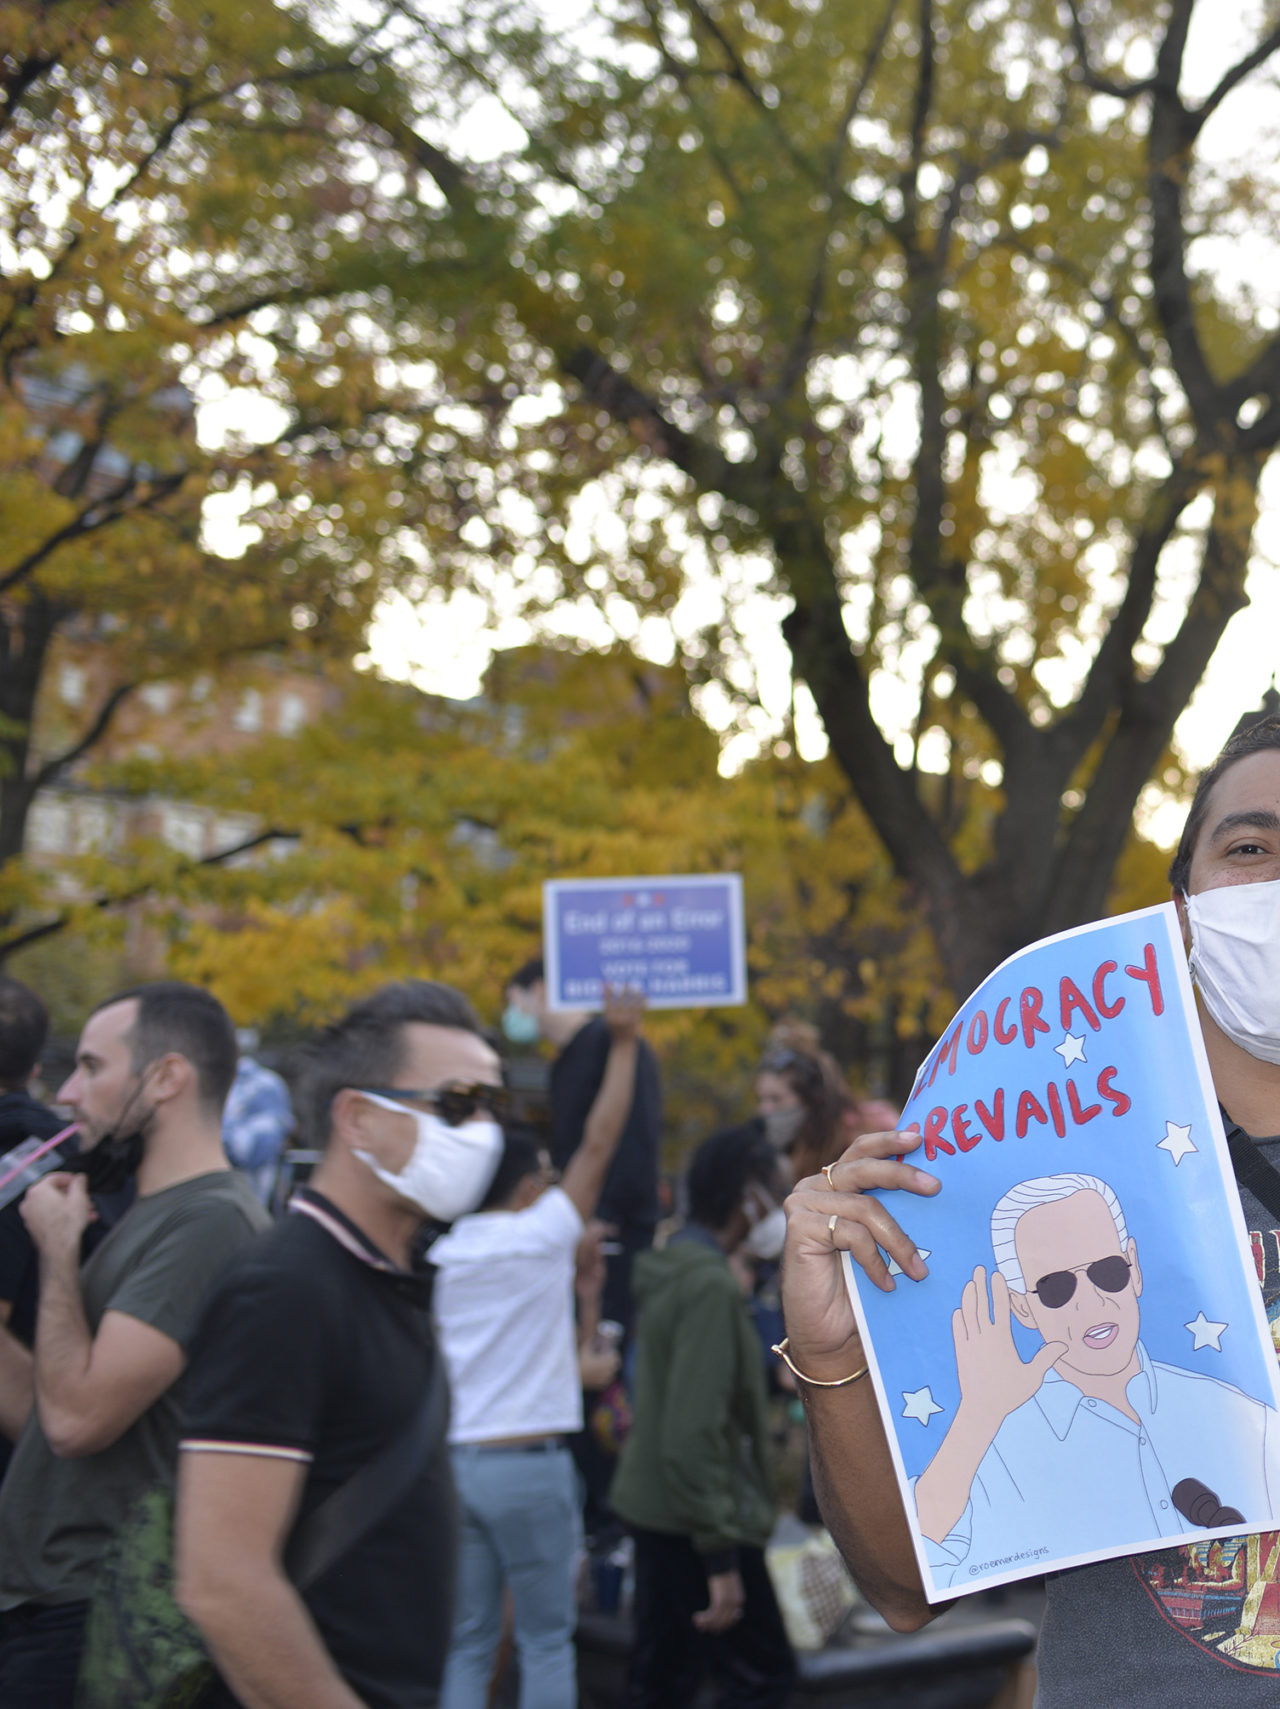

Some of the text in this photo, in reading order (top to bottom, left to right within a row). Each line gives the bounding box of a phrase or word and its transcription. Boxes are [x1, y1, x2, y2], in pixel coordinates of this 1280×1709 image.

[565, 908, 723, 933] End of an Error
[602, 958, 690, 978] VOTE FOR
[650, 974, 727, 994] HARRIS
[913, 943, 1165, 1101] EMOCRACY
[969, 1546, 1050, 1576] @roemerdesigns
